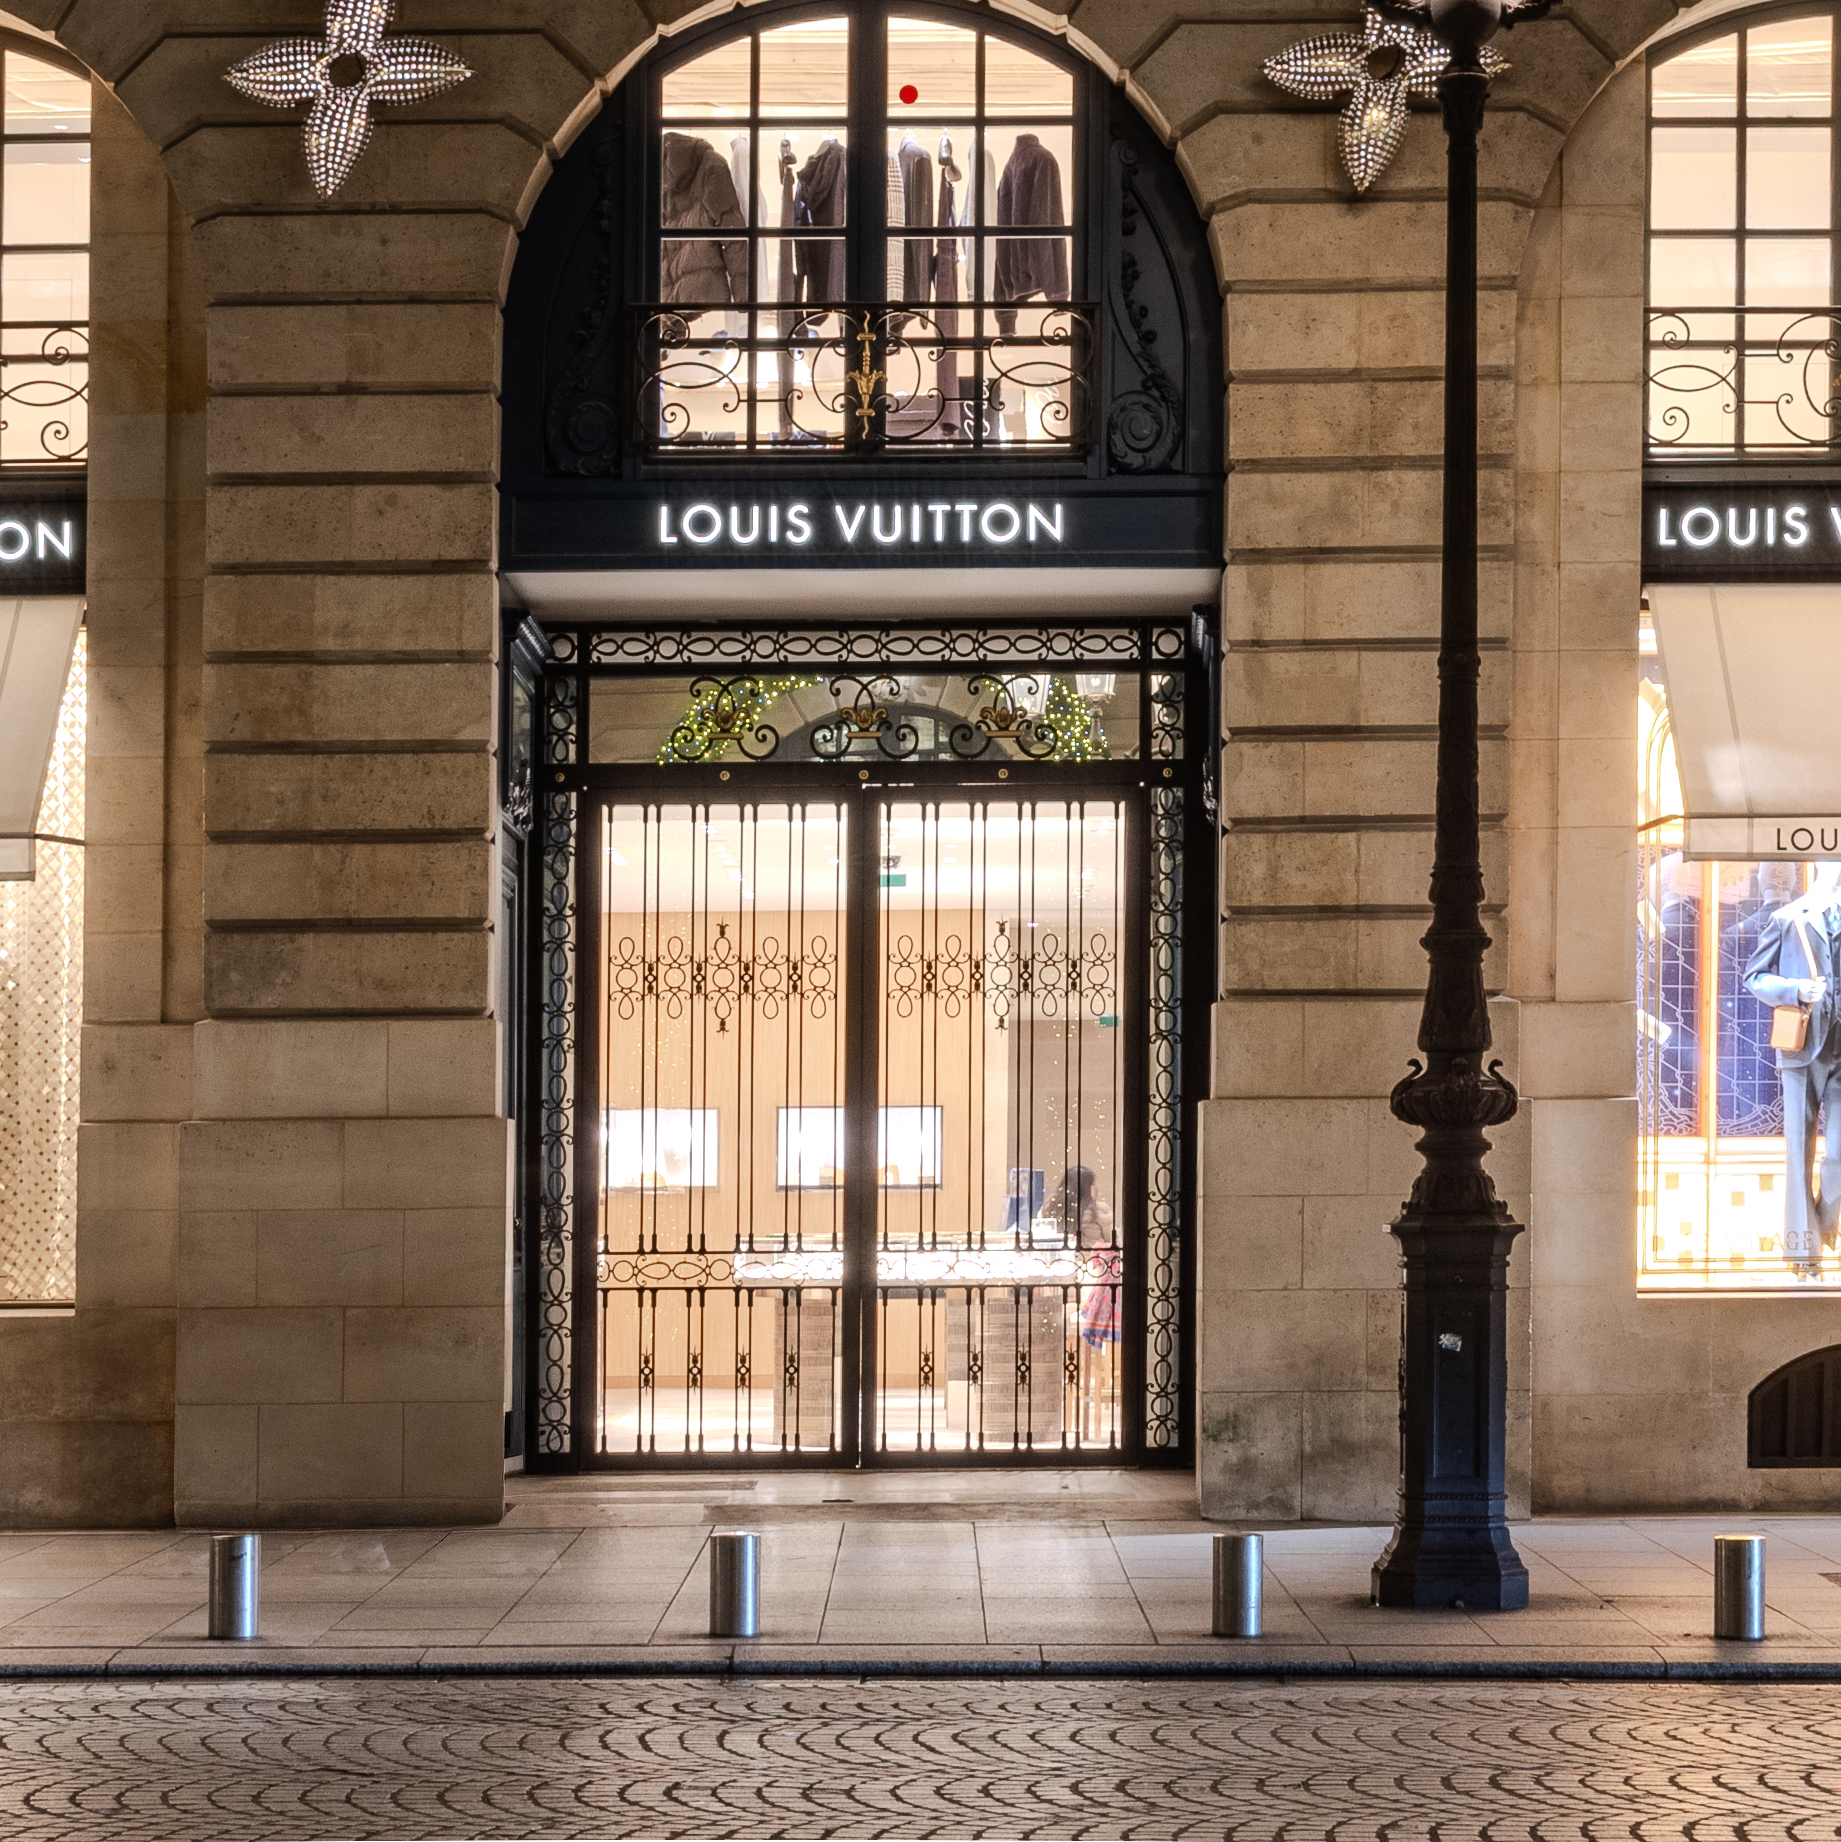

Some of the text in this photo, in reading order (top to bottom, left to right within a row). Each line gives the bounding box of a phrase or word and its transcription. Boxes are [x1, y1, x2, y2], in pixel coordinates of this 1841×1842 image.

[660, 503, 1064, 544] LOUIS VUITTON
[1658, 506, 1810, 548] LOUIS
